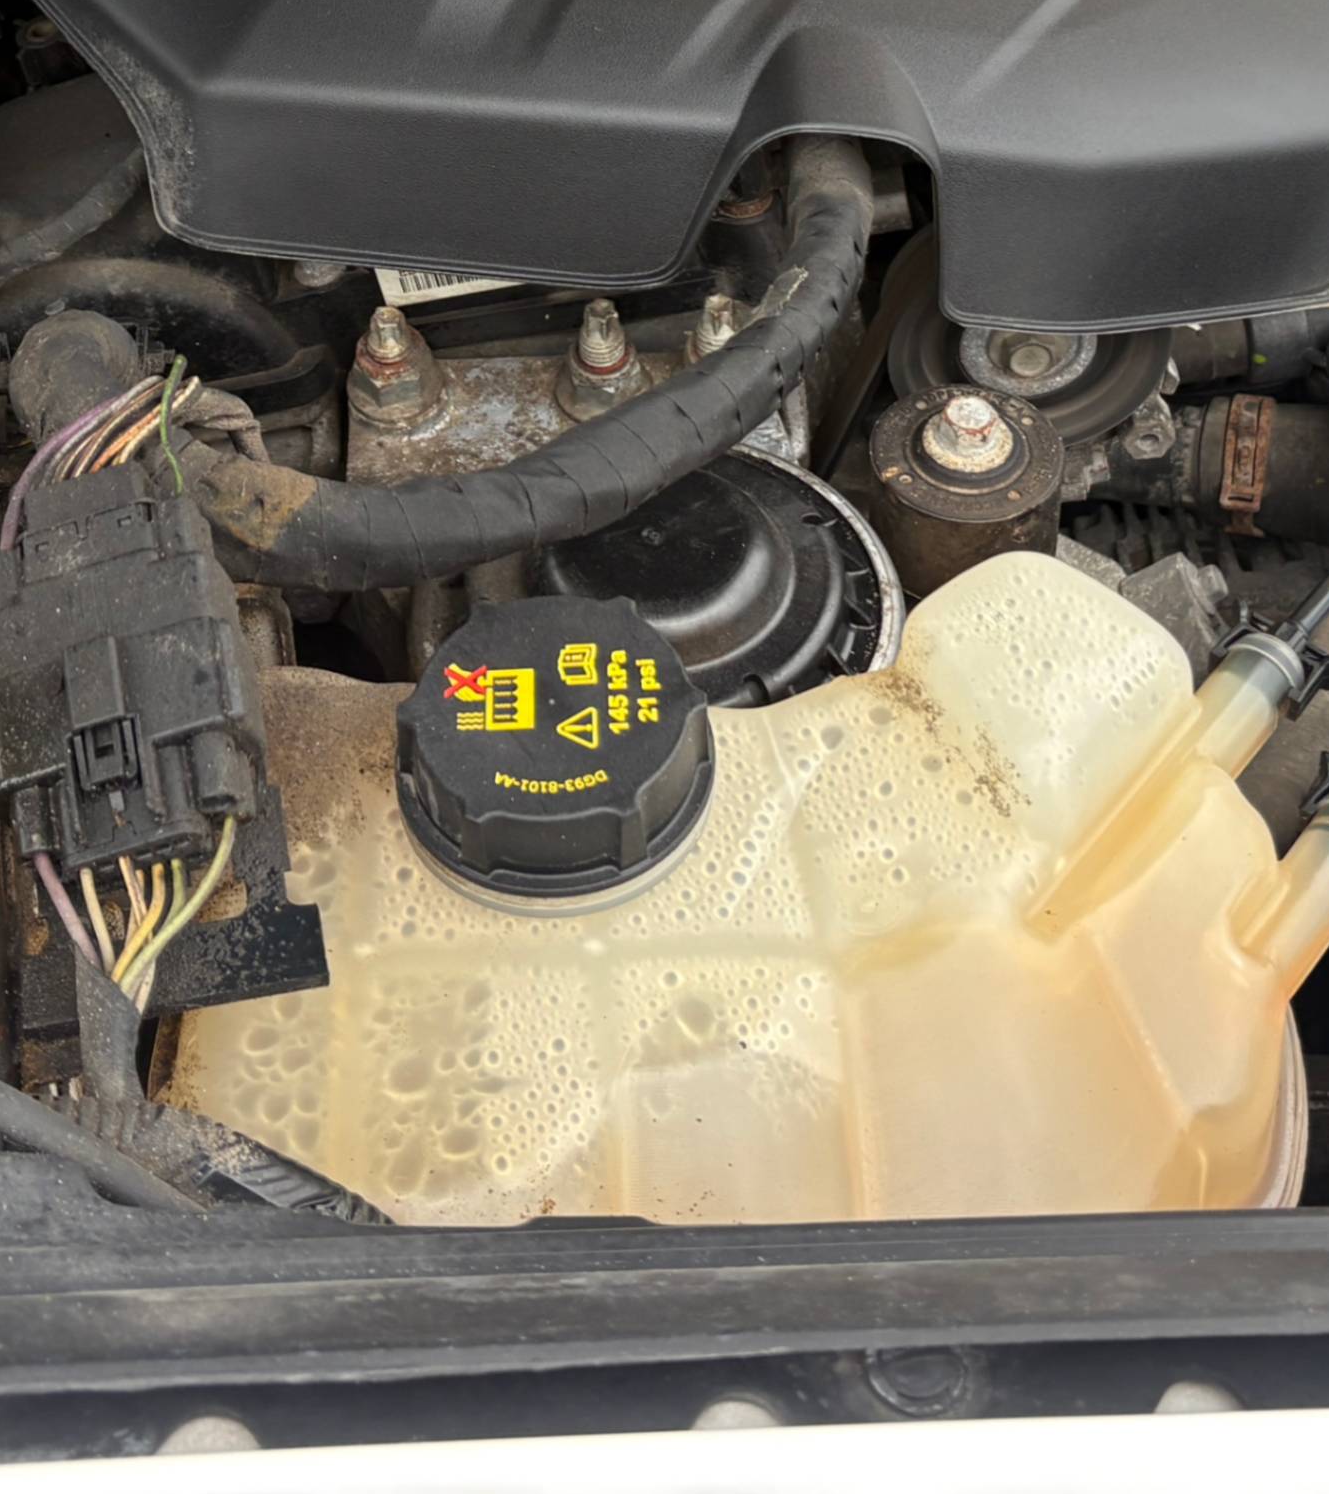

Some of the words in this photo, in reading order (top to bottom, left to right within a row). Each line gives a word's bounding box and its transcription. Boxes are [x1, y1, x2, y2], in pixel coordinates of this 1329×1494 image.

[606, 649, 630, 692] kPa
[634, 658, 662, 692] psi
[608, 694, 631, 735] 145
[636, 694, 660, 724] 21
[493, 769, 609, 795] DG93-8101-AA
